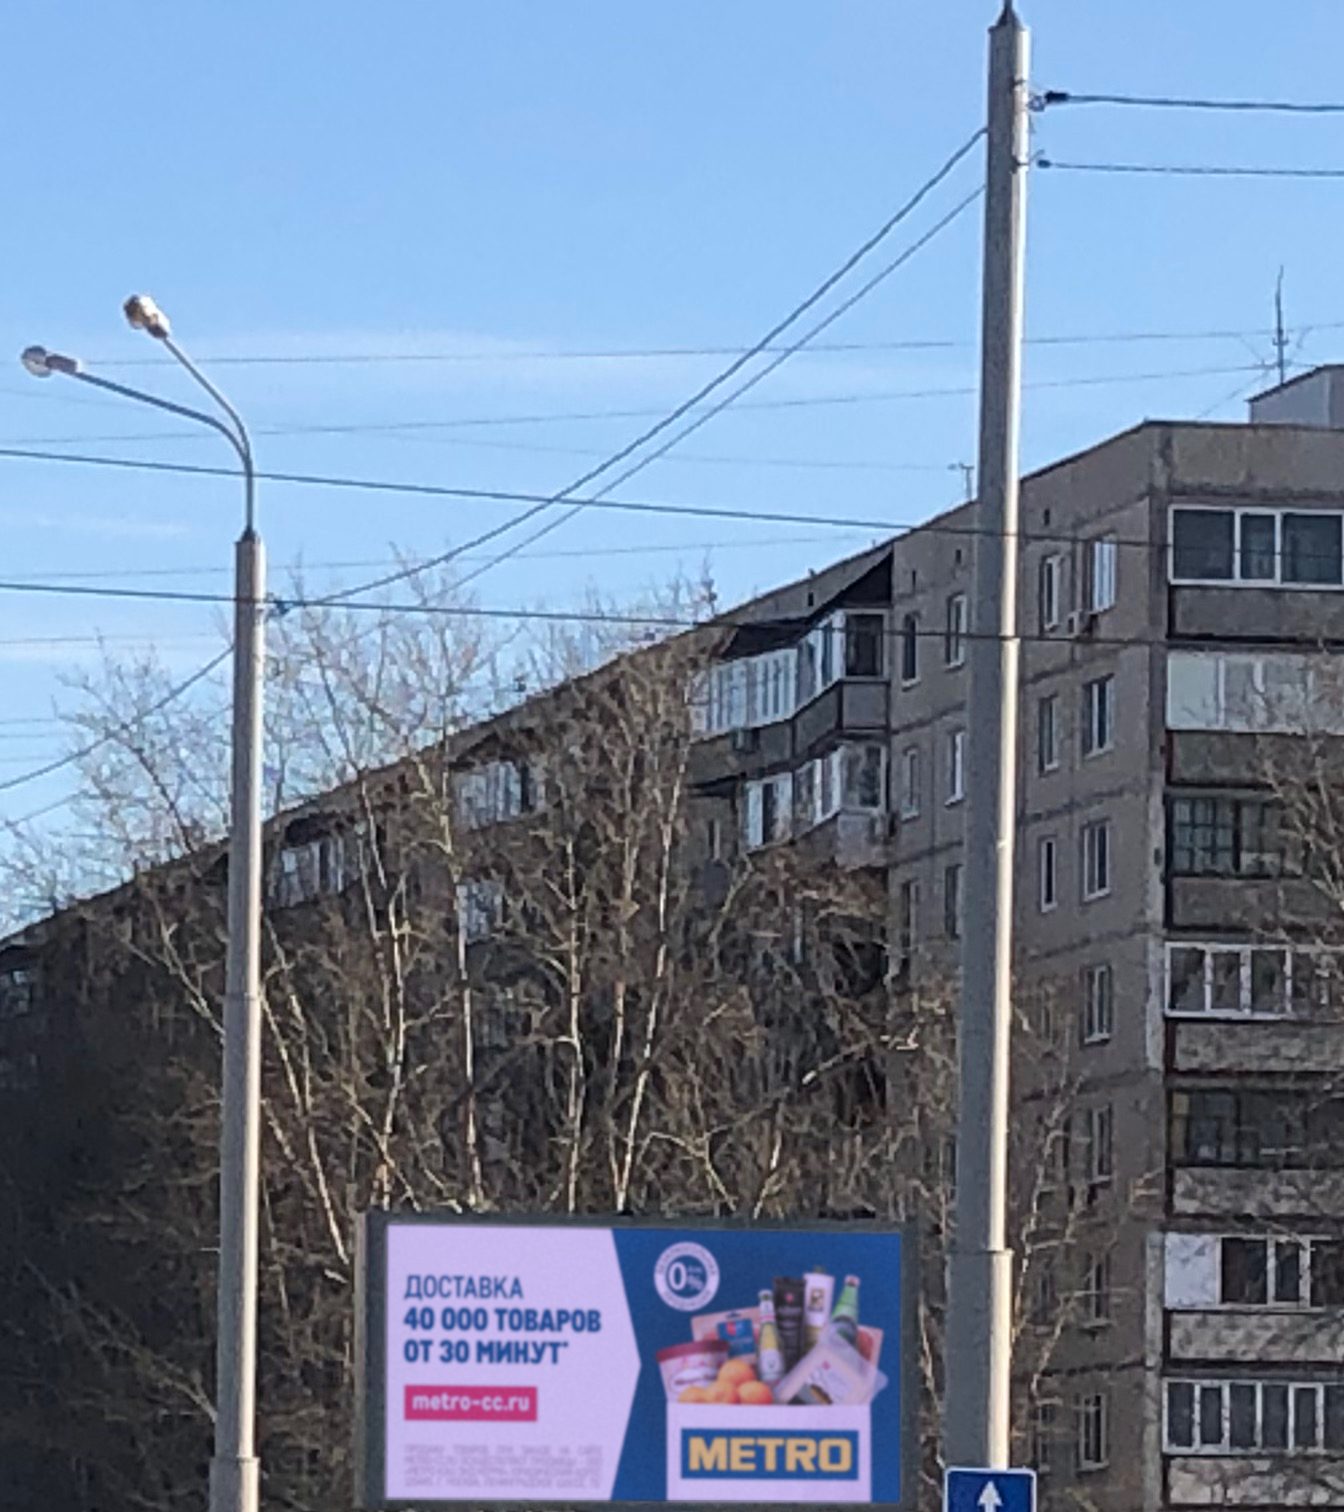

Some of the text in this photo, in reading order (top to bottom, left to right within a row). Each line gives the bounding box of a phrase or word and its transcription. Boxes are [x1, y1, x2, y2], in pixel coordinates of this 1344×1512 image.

[404, 1275, 524, 1300] ДОСТАВКА
[404, 1307, 602, 1333] 40 000 ТОВАРОВ
[404, 1339, 433, 1363] ОТ
[440, 1339, 469, 1363] 30
[412, 1393, 530, 1411] metro-cc.ru
[689, 1437, 852, 1472] METRO
